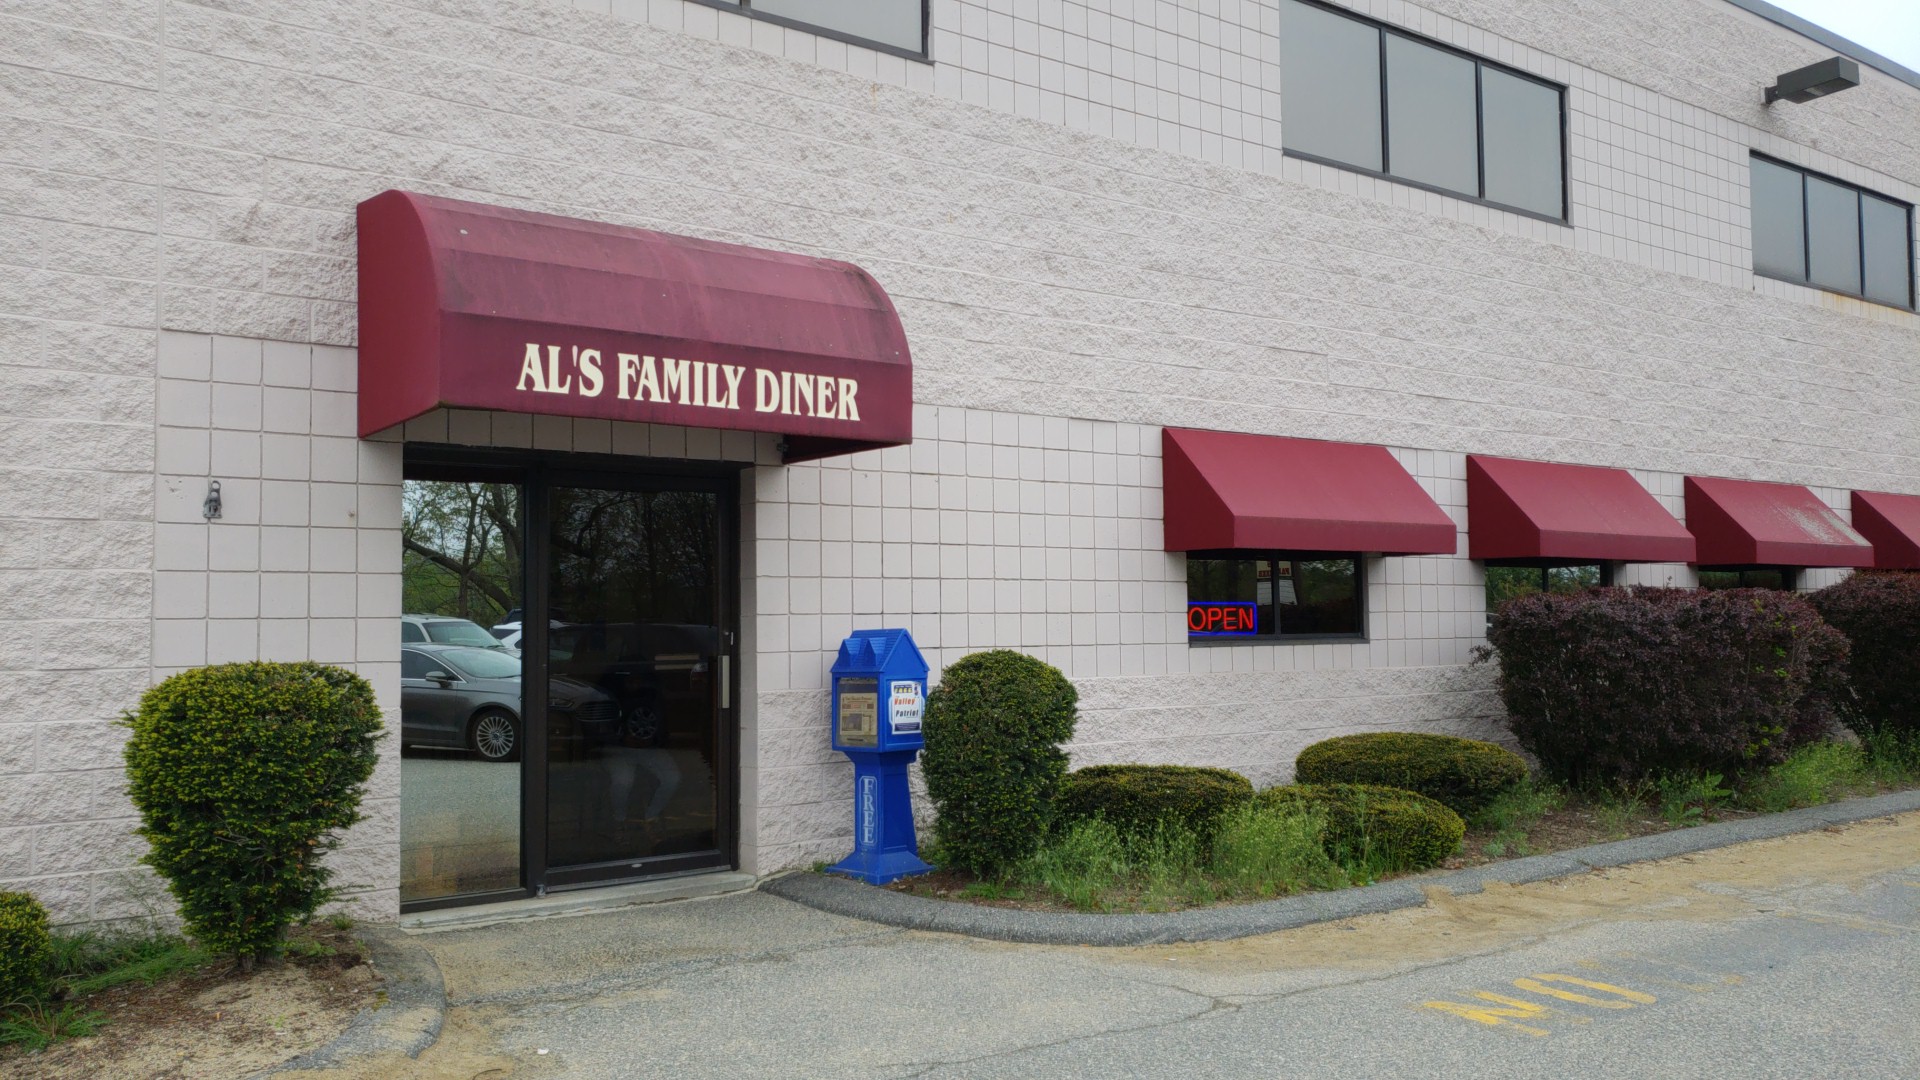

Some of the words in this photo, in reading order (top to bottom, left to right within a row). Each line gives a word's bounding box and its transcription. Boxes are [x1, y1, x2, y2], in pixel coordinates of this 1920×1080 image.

[515, 342, 604, 398] AL'S
[617, 352, 746, 410] FAMILY
[755, 368, 861, 421] DINER
[1187, 606, 1254, 631] OPEN
[863, 777, 875, 844] FREE
